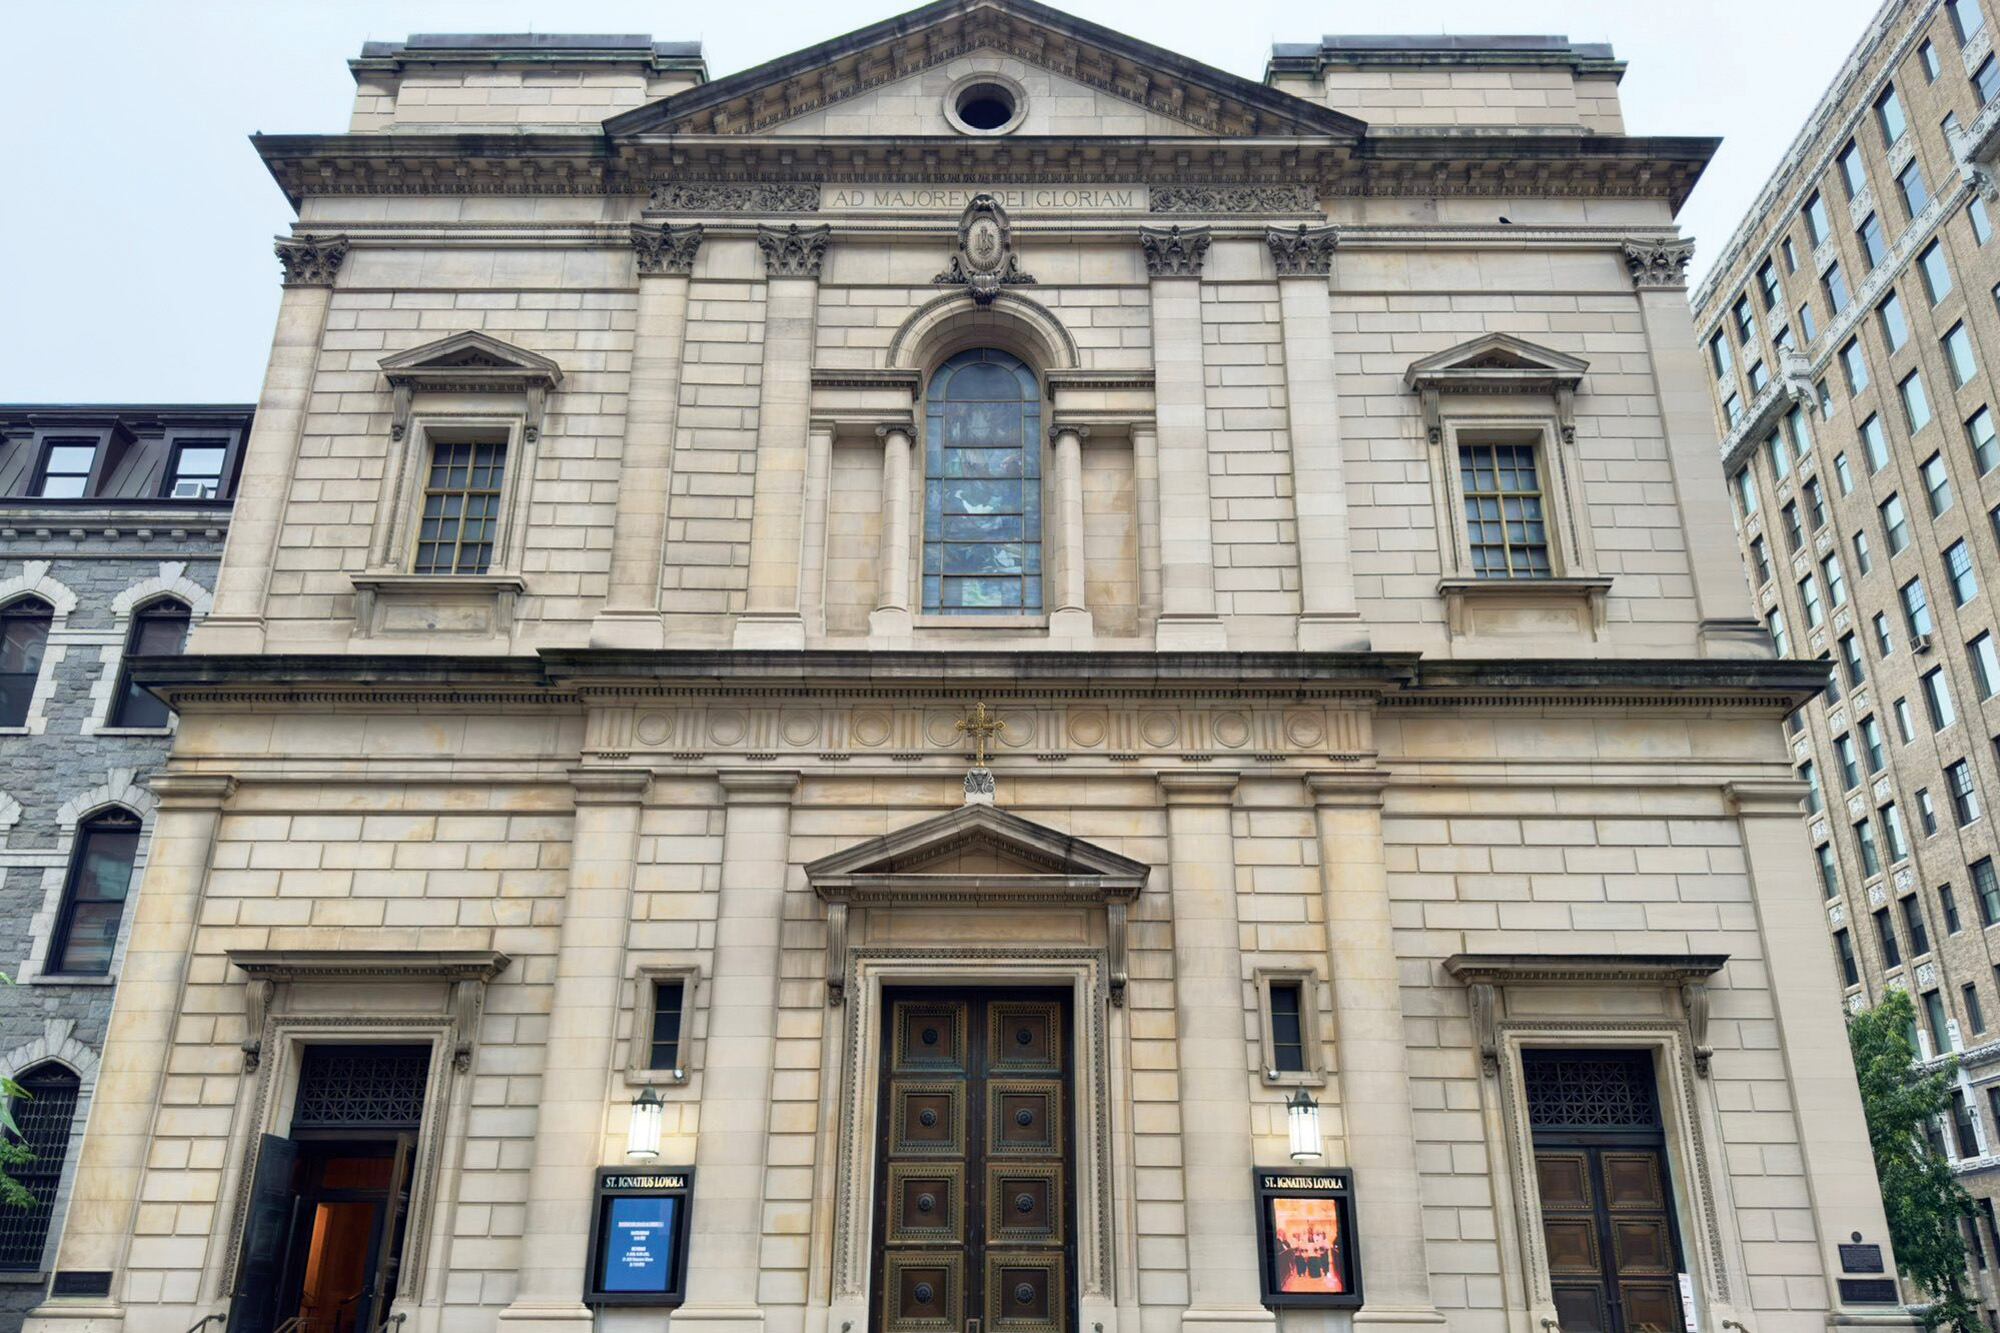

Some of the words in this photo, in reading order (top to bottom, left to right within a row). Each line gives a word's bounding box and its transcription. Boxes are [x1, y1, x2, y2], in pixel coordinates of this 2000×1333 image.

[833, 190, 865, 207] AD
[991, 190, 1026, 207] DEI
[1036, 190, 1133, 208] GLORIAM
[605, 1176, 617, 1188] ST.
[618, 1176, 654, 1188] IGNATIUS
[654, 1176, 684, 1188] LOYOLA
[1264, 1176, 1277, 1188] ST.
[1277, 1177, 1313, 1189] IGNATIUS
[1313, 1177, 1343, 1189] LOYOLA
